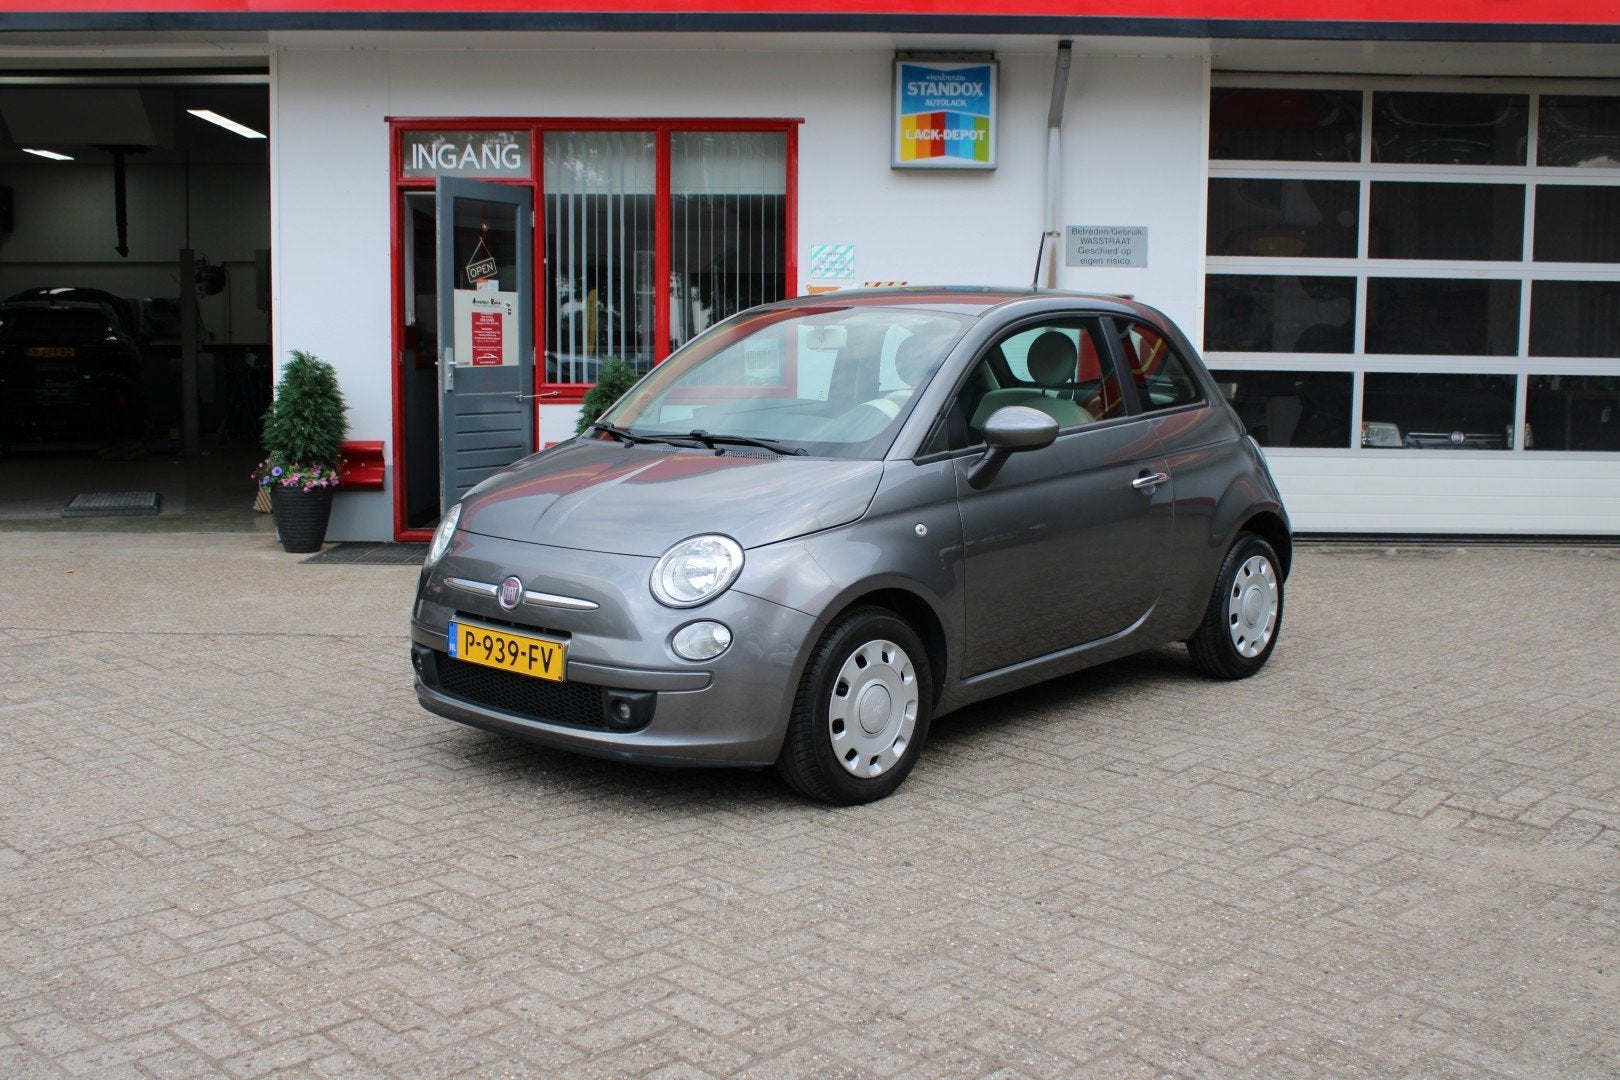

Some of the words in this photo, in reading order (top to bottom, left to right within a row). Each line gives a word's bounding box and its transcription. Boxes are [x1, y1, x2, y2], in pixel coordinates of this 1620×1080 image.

[907, 81, 984, 96] STANDOX
[925, 99, 967, 107] AUTOLACK
[905, 128, 986, 140] LACK-DEPOT
[412, 143, 521, 170] INGANG
[1071, 227, 1143, 236] Betreden/Gebruik
[1080, 237, 1131, 245] WASSTRAAT
[1078, 247, 1118, 255] Geschied
[1121, 248, 1132, 256] op
[1080, 257, 1104, 266] eigen
[469, 261, 494, 278] OPEN
[502, 585, 518, 602] FIAT
[464, 630, 554, 674] P-939-FV
